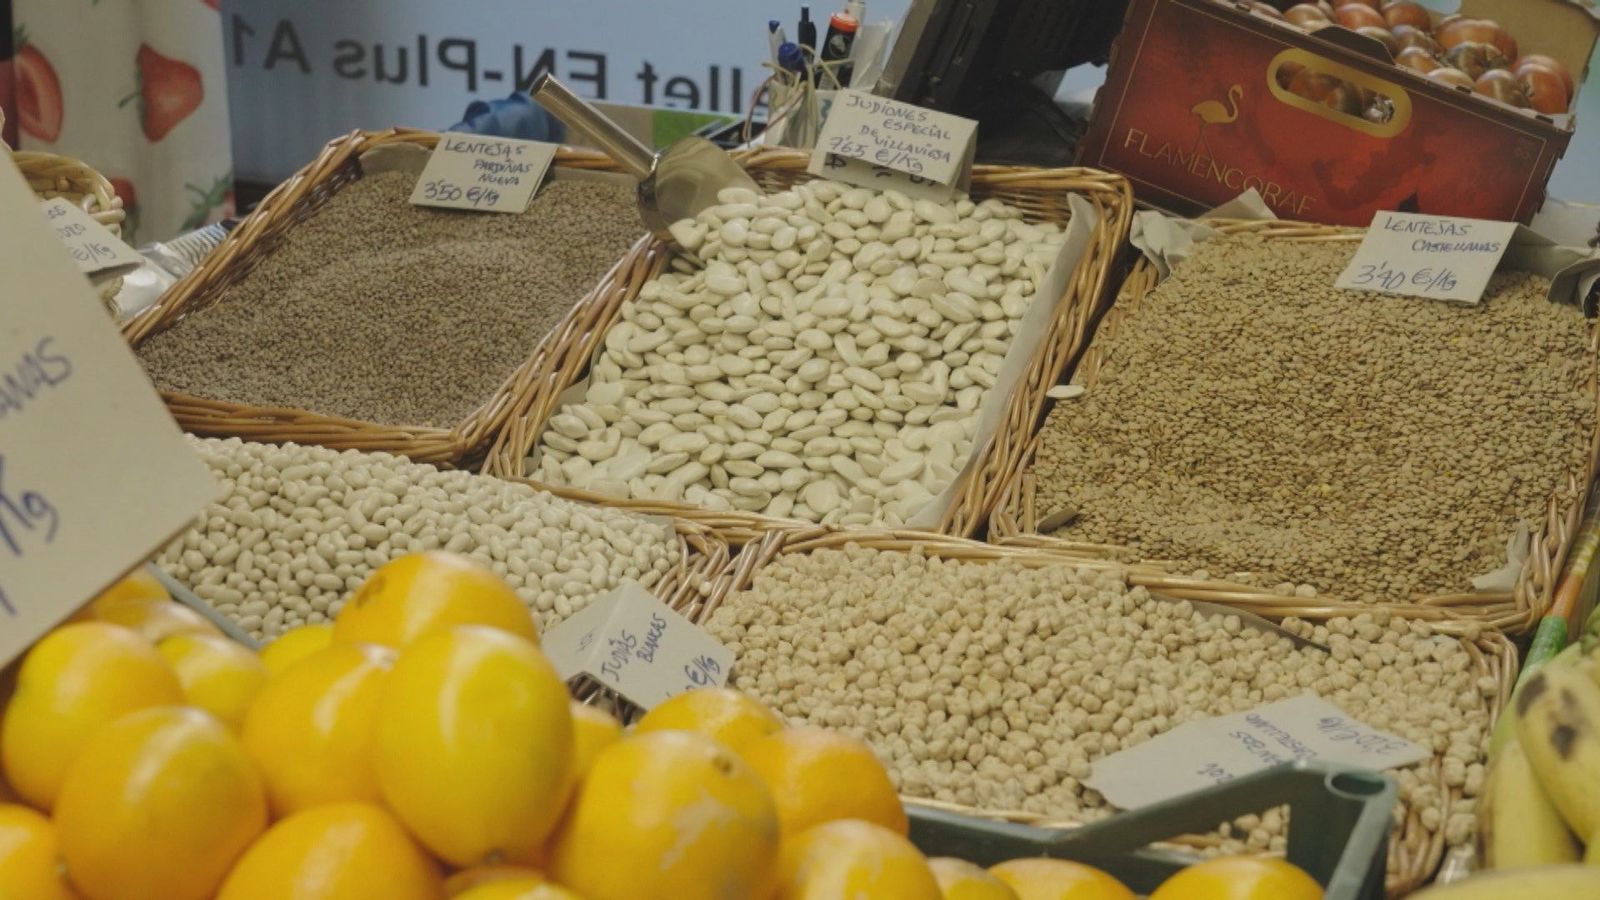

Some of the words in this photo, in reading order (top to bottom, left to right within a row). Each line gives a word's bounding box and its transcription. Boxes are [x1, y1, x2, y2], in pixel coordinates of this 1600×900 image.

[846, 95, 929, 122] JUDIONES
[882, 119, 951, 140] ESPECIAL
[444, 138, 526, 157] LENTEJAS
[1384, 216, 1473, 236] LENTEJAS
